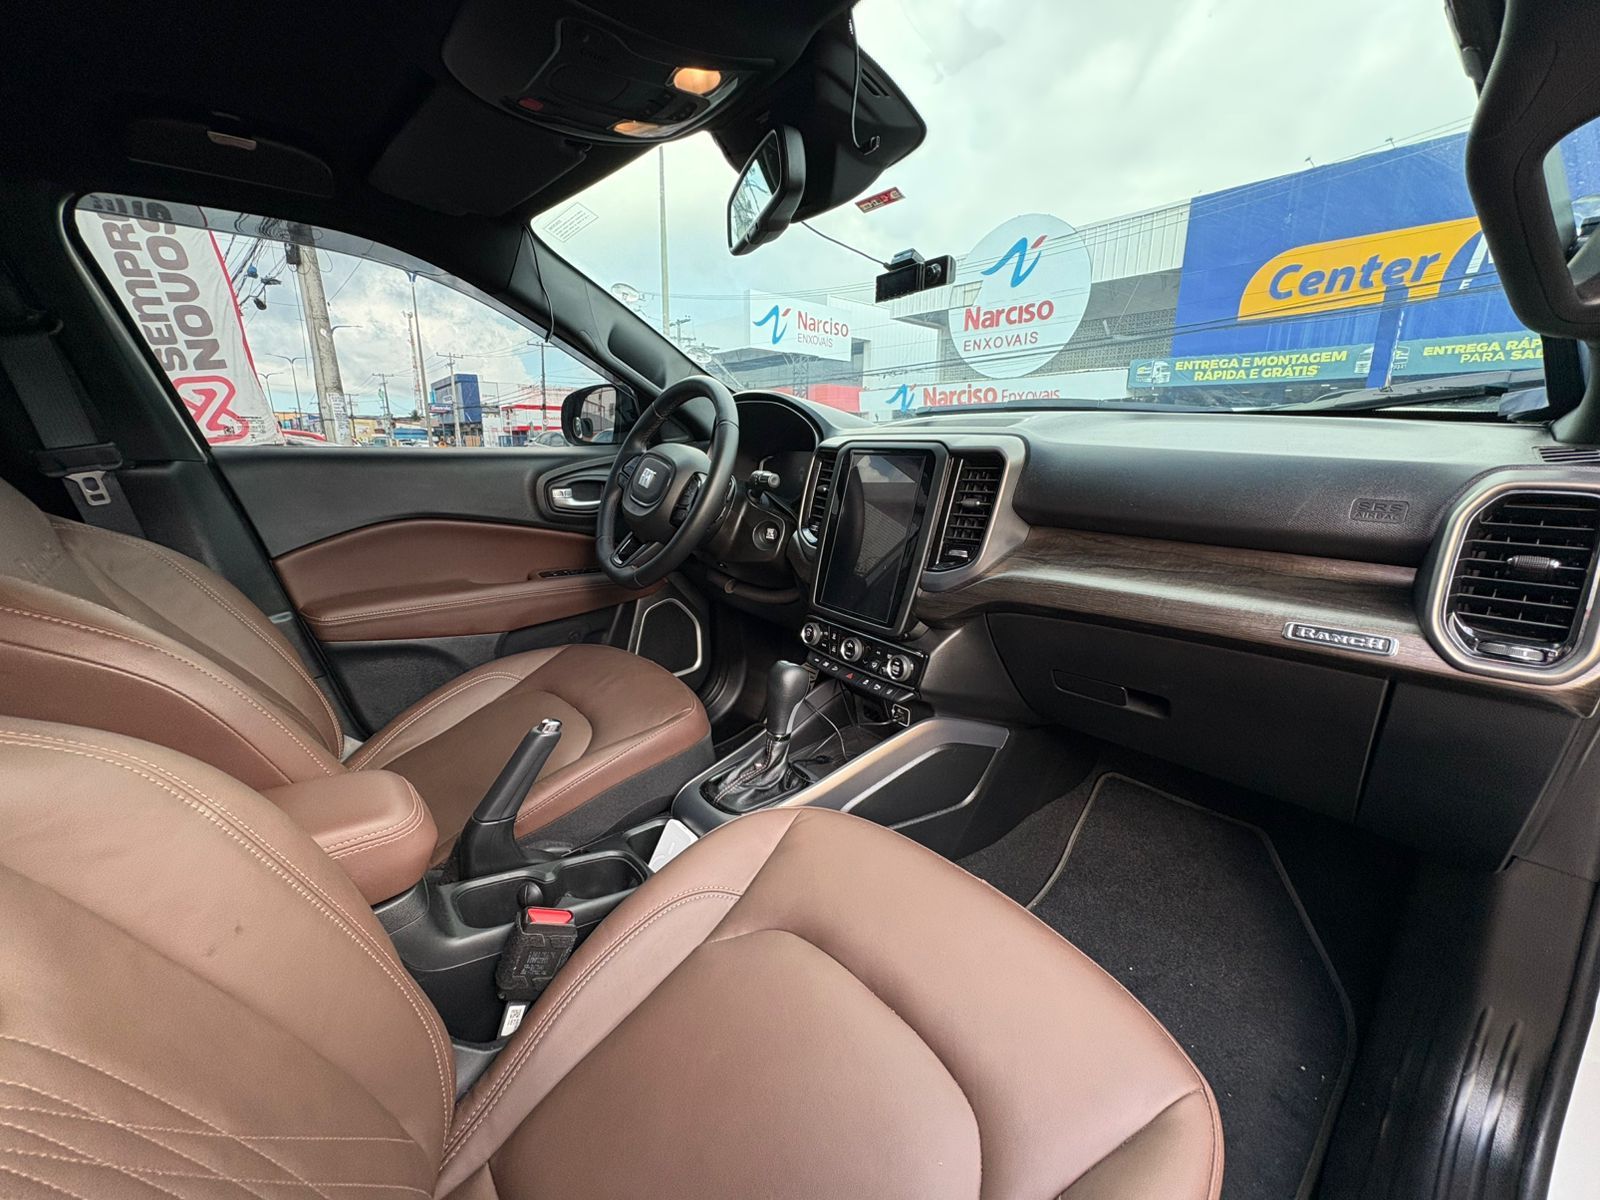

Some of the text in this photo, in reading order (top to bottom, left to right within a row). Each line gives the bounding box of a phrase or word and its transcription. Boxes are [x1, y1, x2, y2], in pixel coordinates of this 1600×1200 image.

[1269, 252, 1442, 300] Center
[797, 310, 849, 338] Narciso
[964, 299, 1054, 332] Narciso
[797, 333, 833, 348] ENXOVAIS
[963, 331, 1039, 352] ENXOVAIS
[1423, 341, 1501, 357] ENTREGA
[1175, 350, 1348, 371] ENTREGA E MONTAGEM
[1460, 350, 1505, 364] PARA
[1194, 367, 1248, 381] RÁPIDA
[1249, 368, 1259, 379] E
[923, 384, 998, 406] Narciso
[1357, 501, 1404, 512] SRS
[1297, 626, 1385, 650] RANCH
